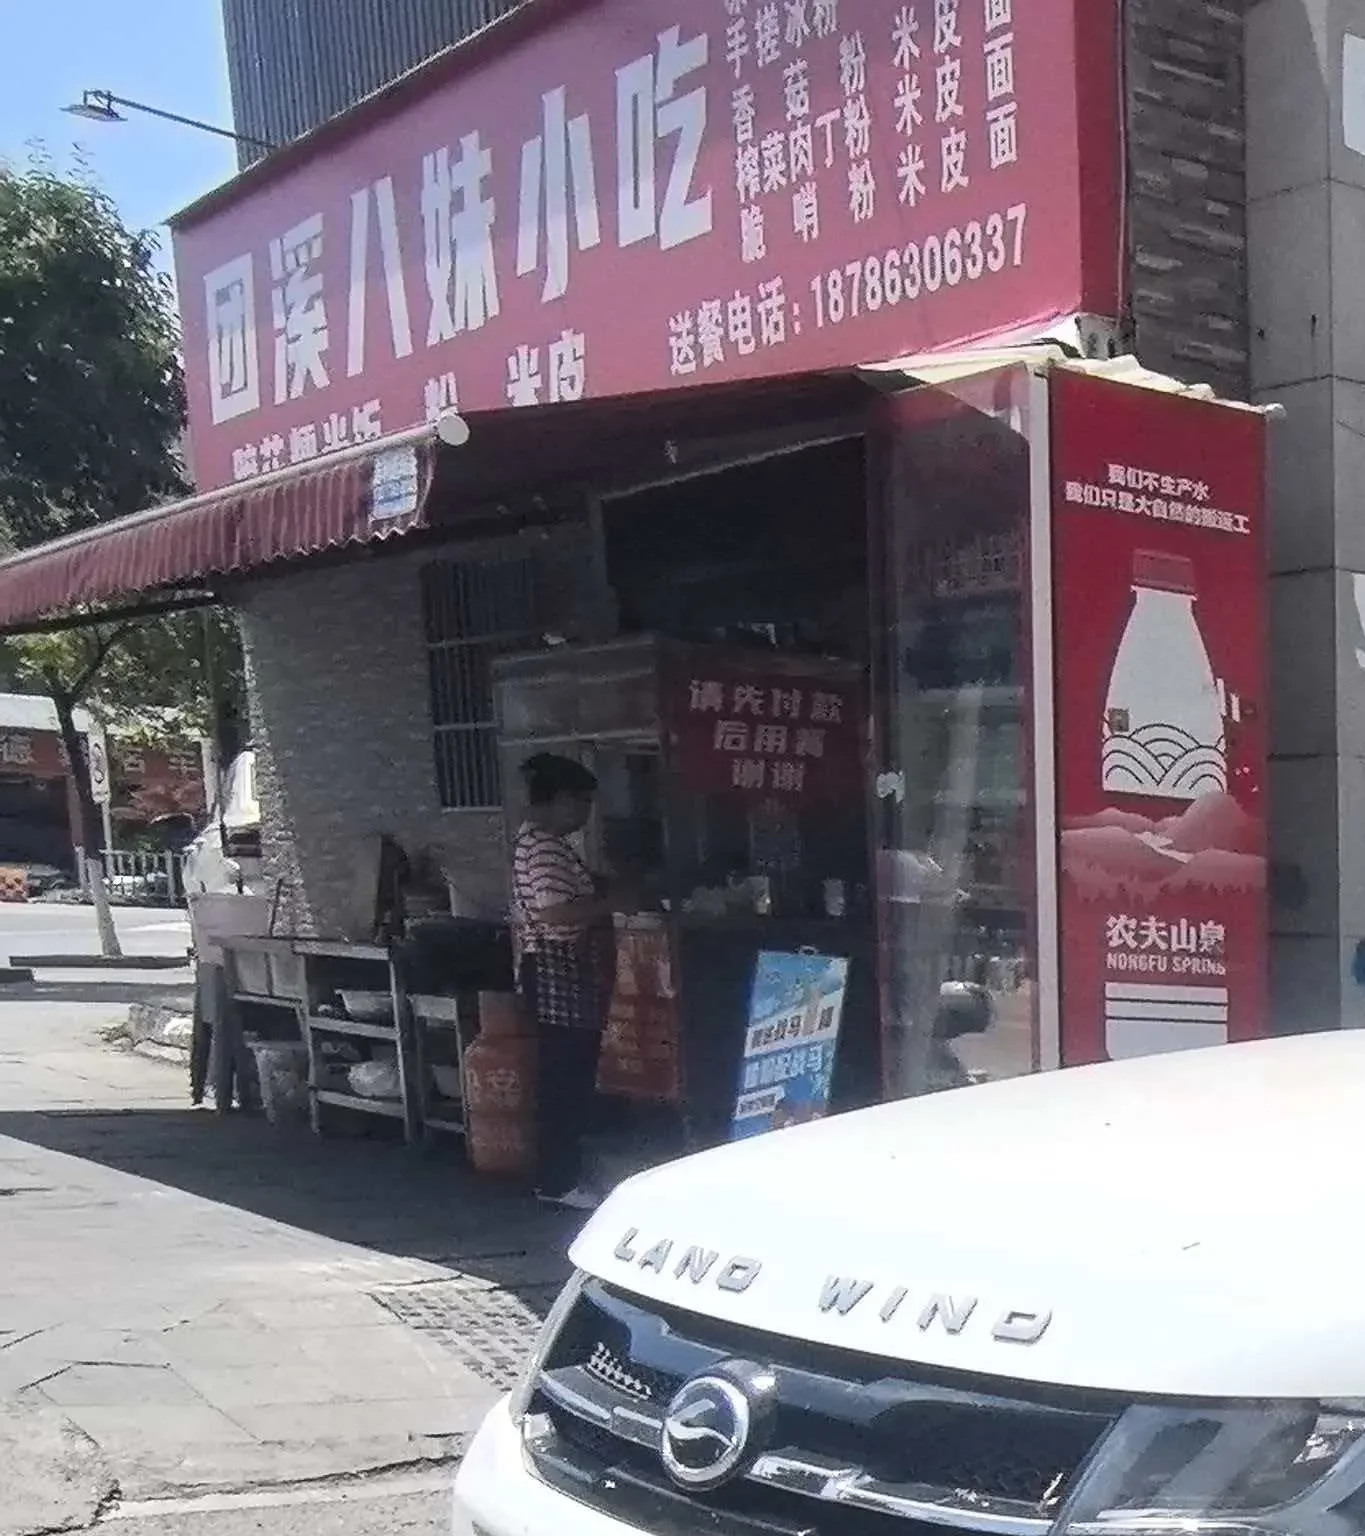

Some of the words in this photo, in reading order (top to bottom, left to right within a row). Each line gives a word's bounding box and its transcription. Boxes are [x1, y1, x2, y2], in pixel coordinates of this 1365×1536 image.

[844, 93, 872, 159] 粉
[984, 32, 1014, 101] 面
[848, 157, 877, 224] 粉
[986, 101, 1019, 170] 面
[1108, 463, 1210, 501] 我们不生产水
[1105, 914, 1226, 954] 农夫山泉
[613, 1227, 763, 1293] LAND
[817, 1273, 1054, 1346] WIND
